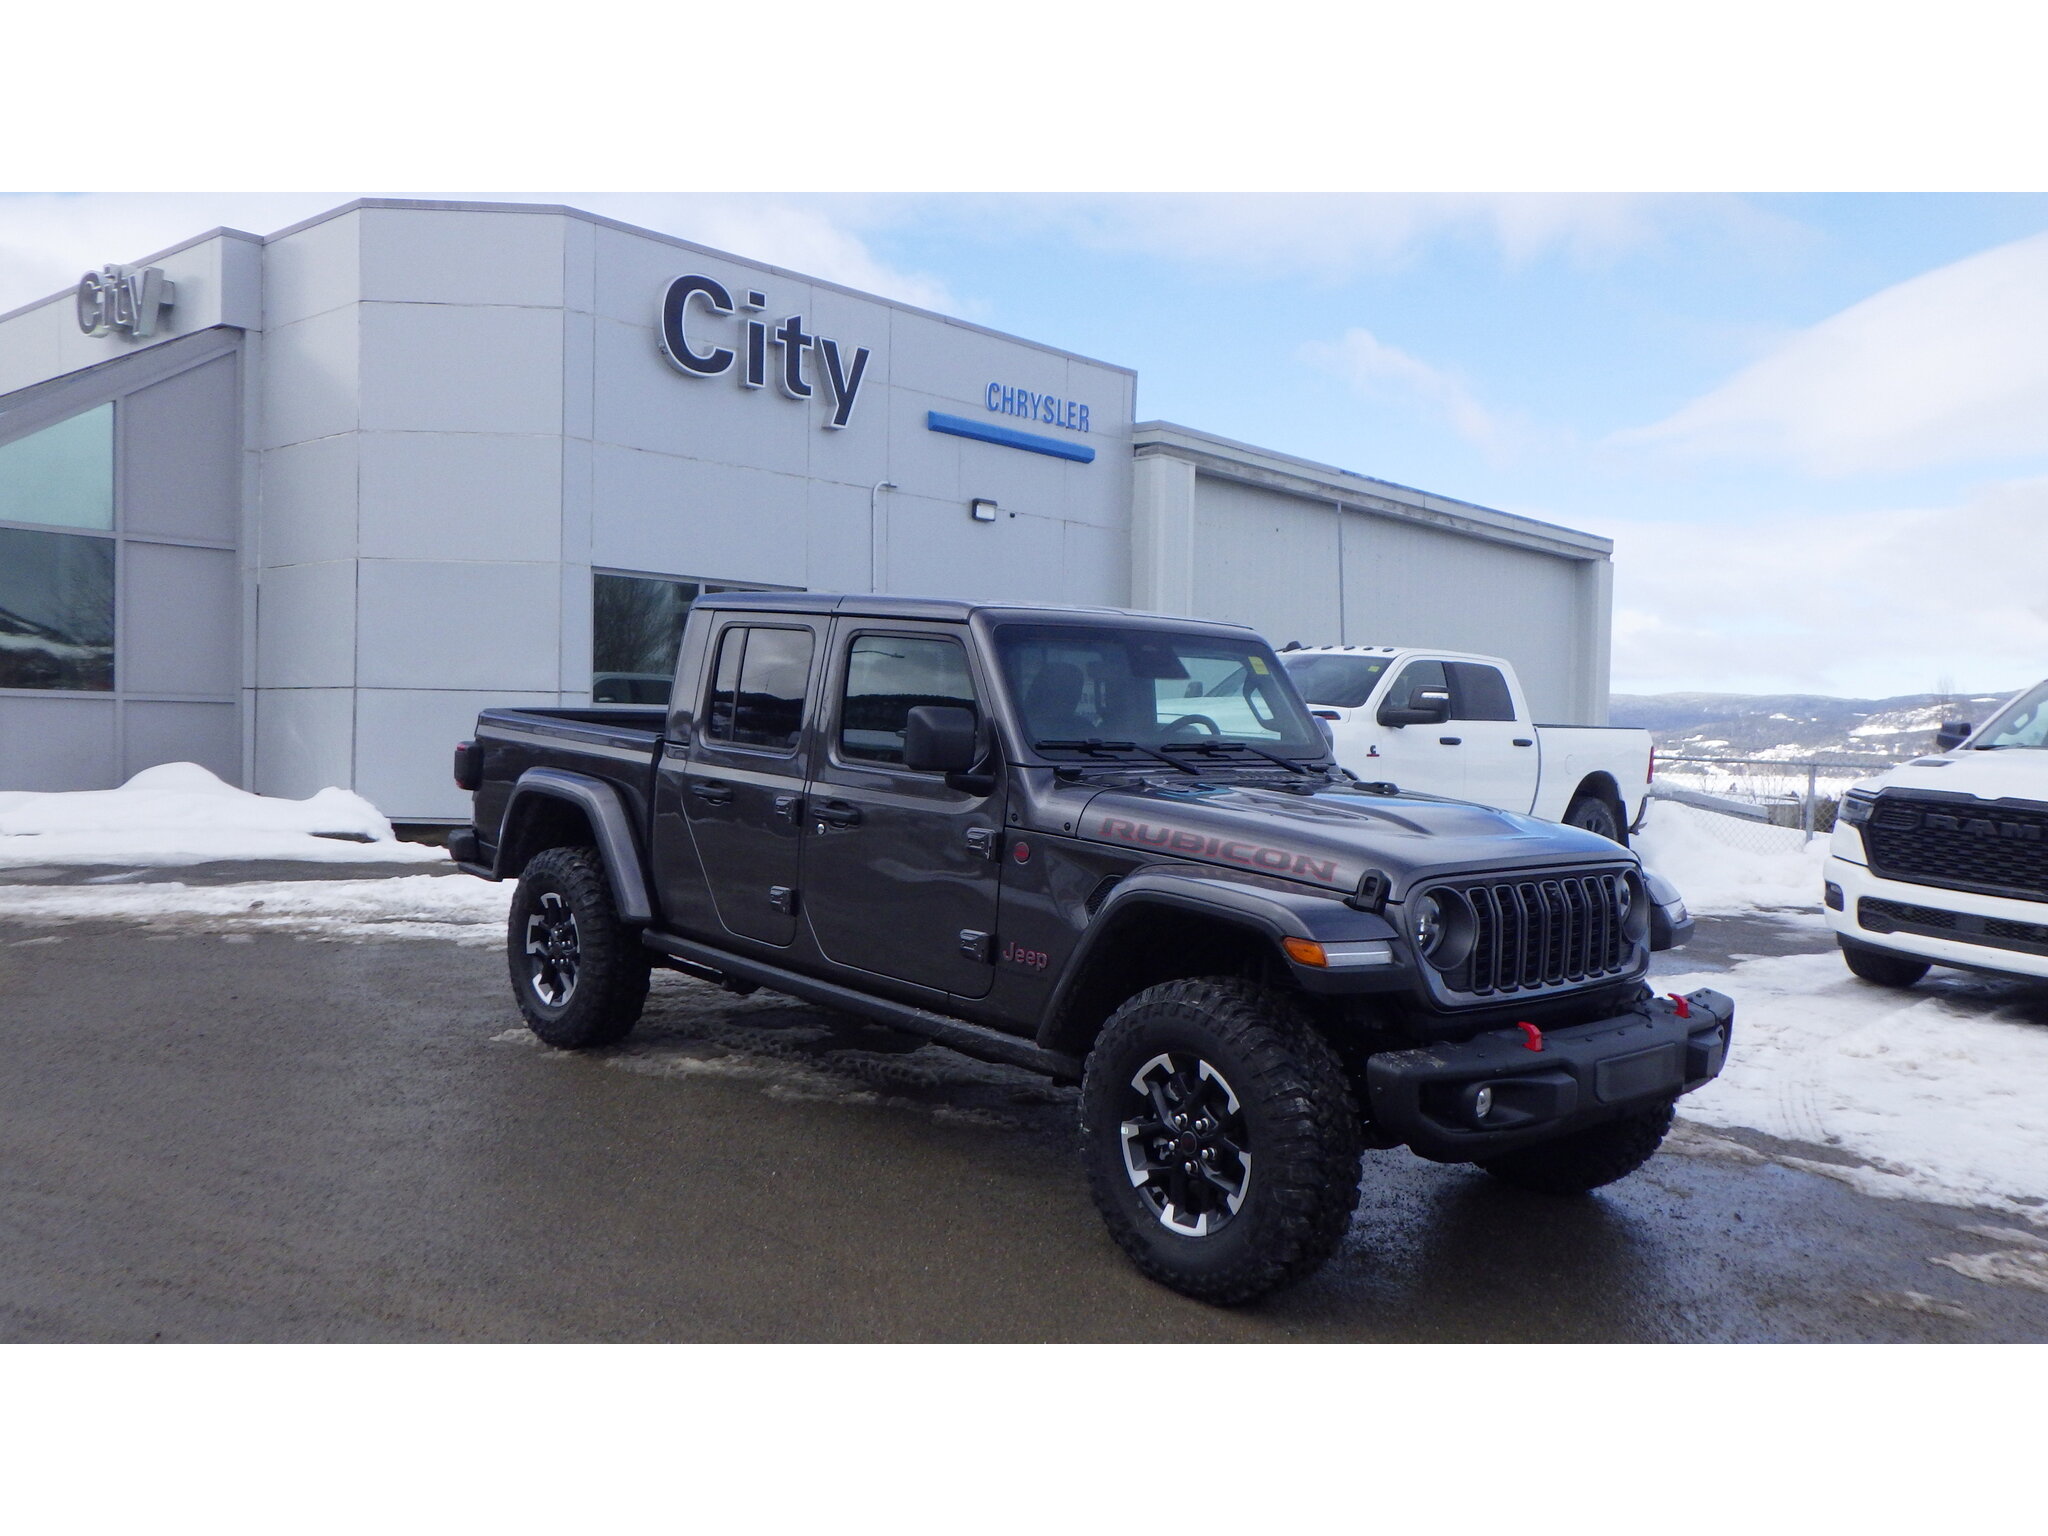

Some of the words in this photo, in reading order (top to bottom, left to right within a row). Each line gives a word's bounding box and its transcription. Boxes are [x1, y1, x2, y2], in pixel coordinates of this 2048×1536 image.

[78, 264, 161, 337] City
[659, 273, 871, 430] City
[985, 381, 1090, 433] CHRYSLER
[1101, 816, 1338, 883] RUBICON
[1925, 812, 2041, 840] RAM
[1002, 942, 1048, 971] Jeep
